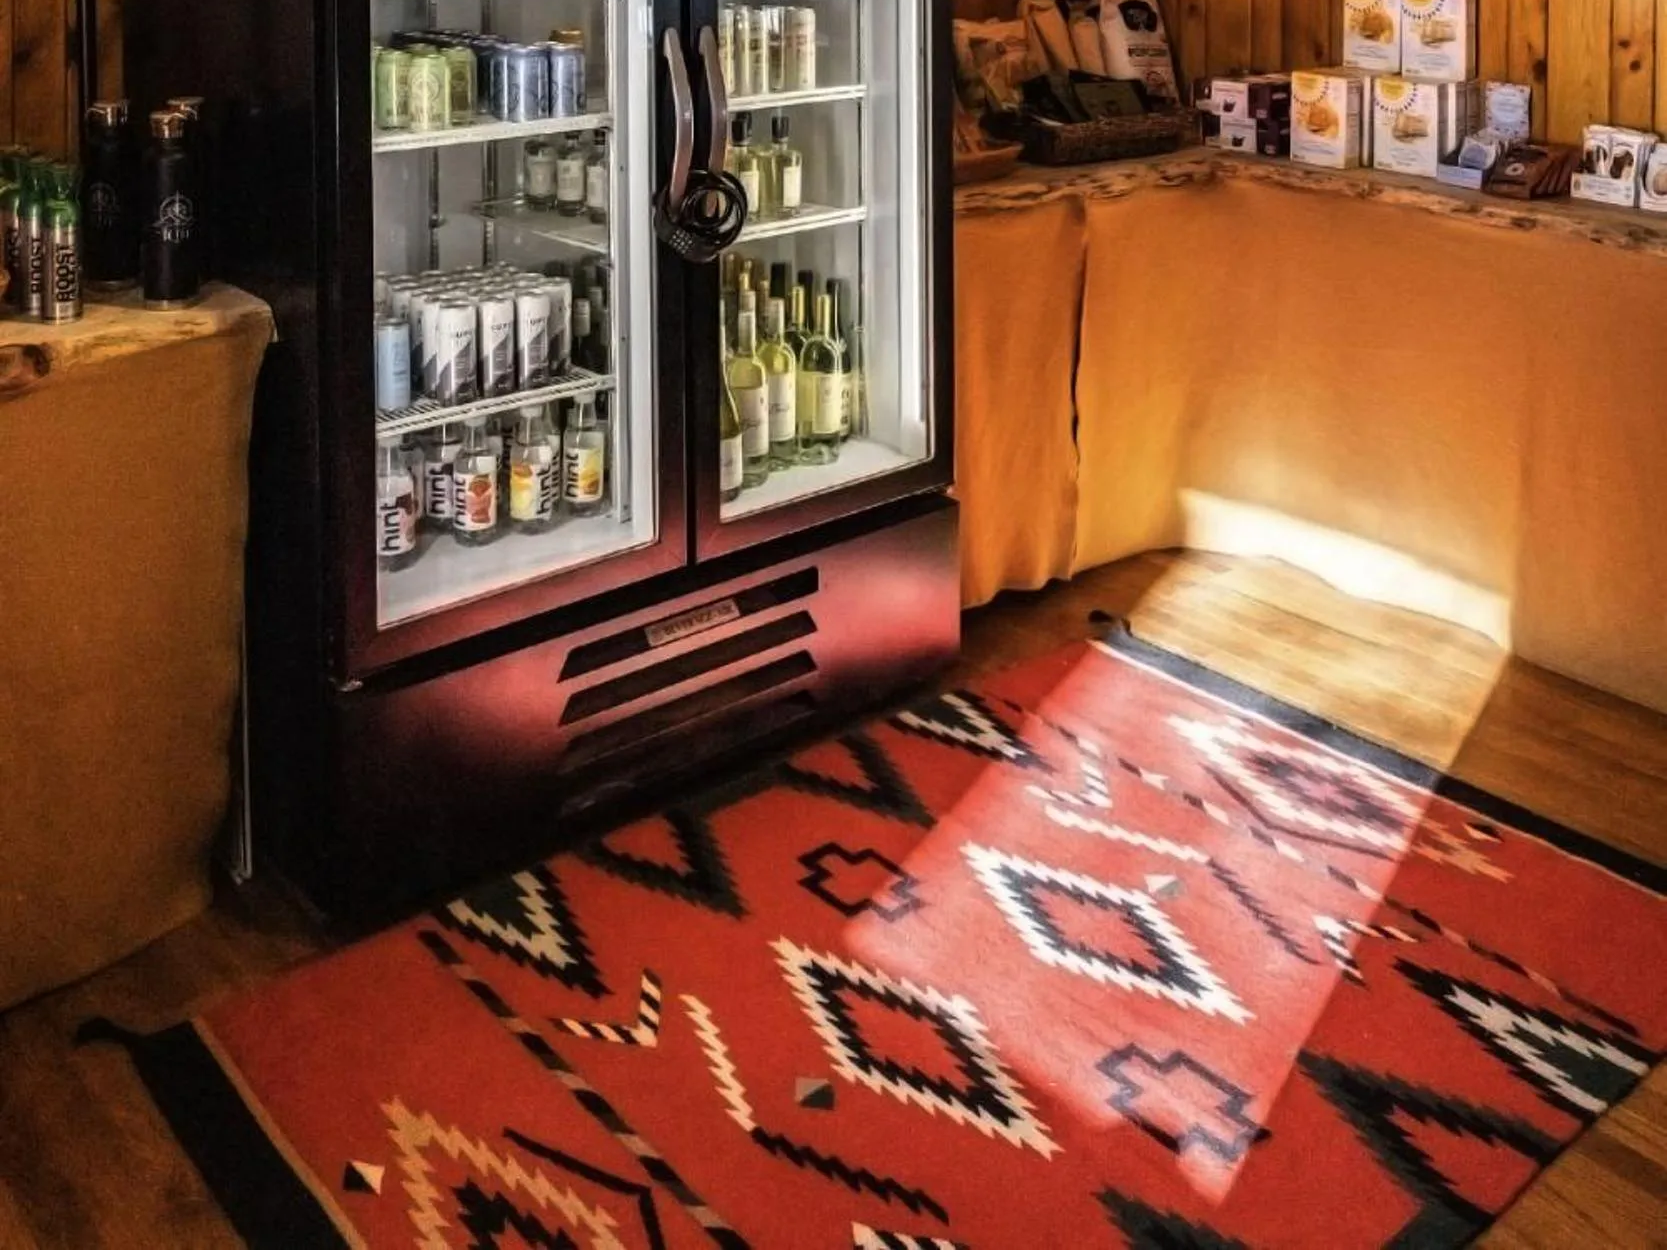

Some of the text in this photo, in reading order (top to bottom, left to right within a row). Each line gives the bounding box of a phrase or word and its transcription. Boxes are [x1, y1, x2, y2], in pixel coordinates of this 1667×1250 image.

[428, 467, 446, 514] hint
[536, 466, 551, 514] hint
[379, 502, 402, 551] hint
